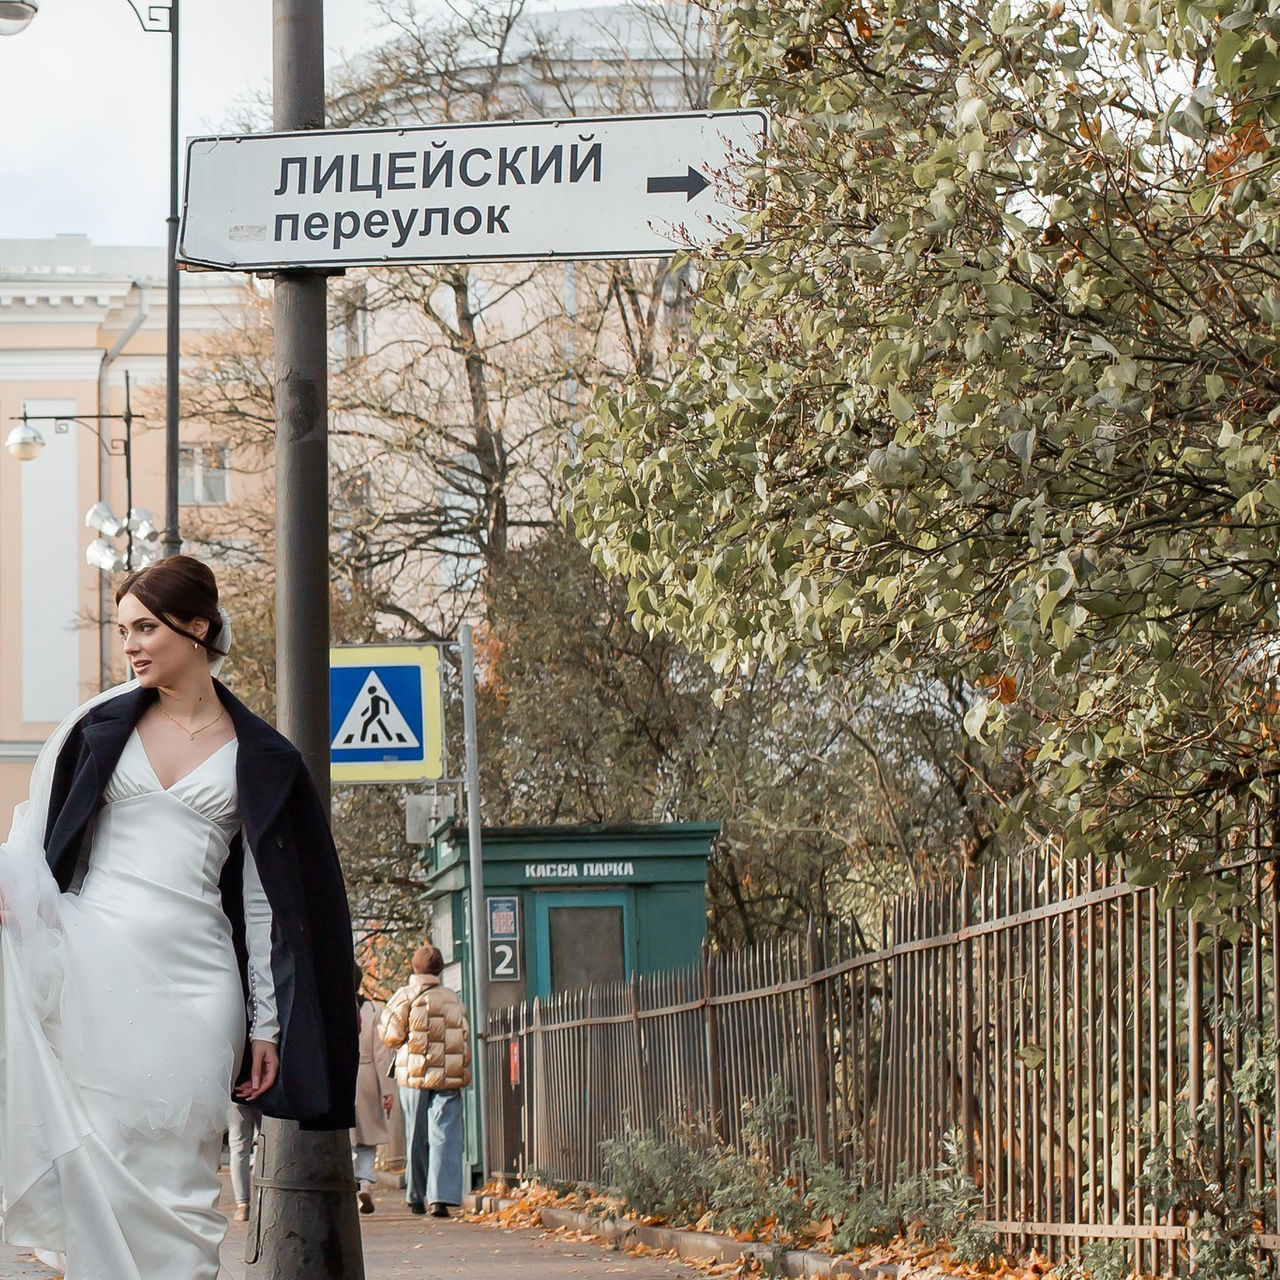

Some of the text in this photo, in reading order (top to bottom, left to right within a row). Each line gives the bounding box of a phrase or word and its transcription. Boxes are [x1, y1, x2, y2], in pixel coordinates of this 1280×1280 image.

[274, 133, 602, 199] ЛИЦЕЙСКИЙ
[274, 205, 510, 250] переулок
[525, 862, 634, 878] КАССА ПАРКА
[494, 944, 515, 975] 2
